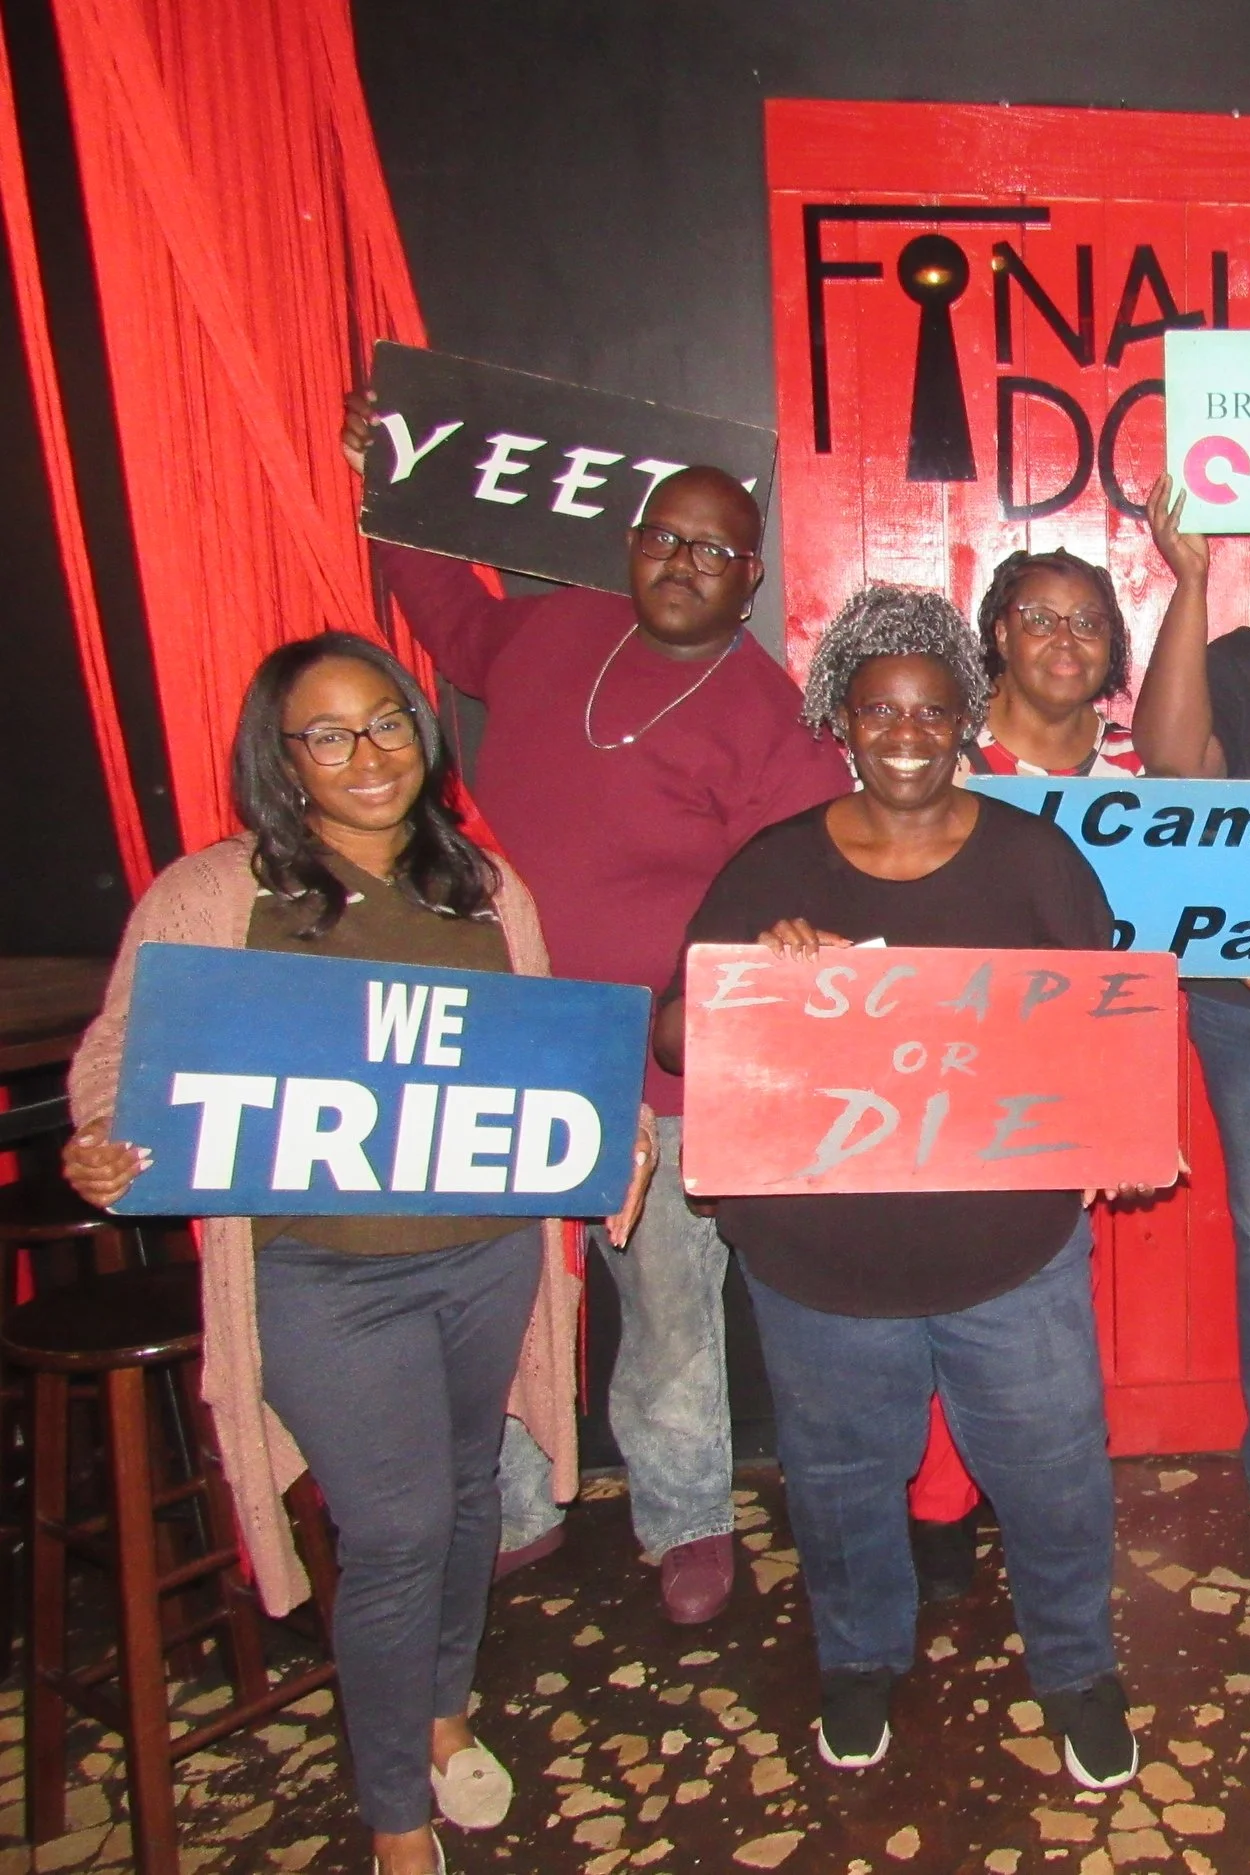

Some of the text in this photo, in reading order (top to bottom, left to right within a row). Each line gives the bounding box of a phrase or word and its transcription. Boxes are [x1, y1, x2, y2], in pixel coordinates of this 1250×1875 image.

[378, 412, 758, 528] YEET
[367, 980, 468, 1066] WE
[702, 961, 1166, 1022] ESCAPE
[892, 1041, 979, 1077] OR
[170, 1072, 602, 1194] TRIED
[764, 1087, 1090, 1186] DIE
